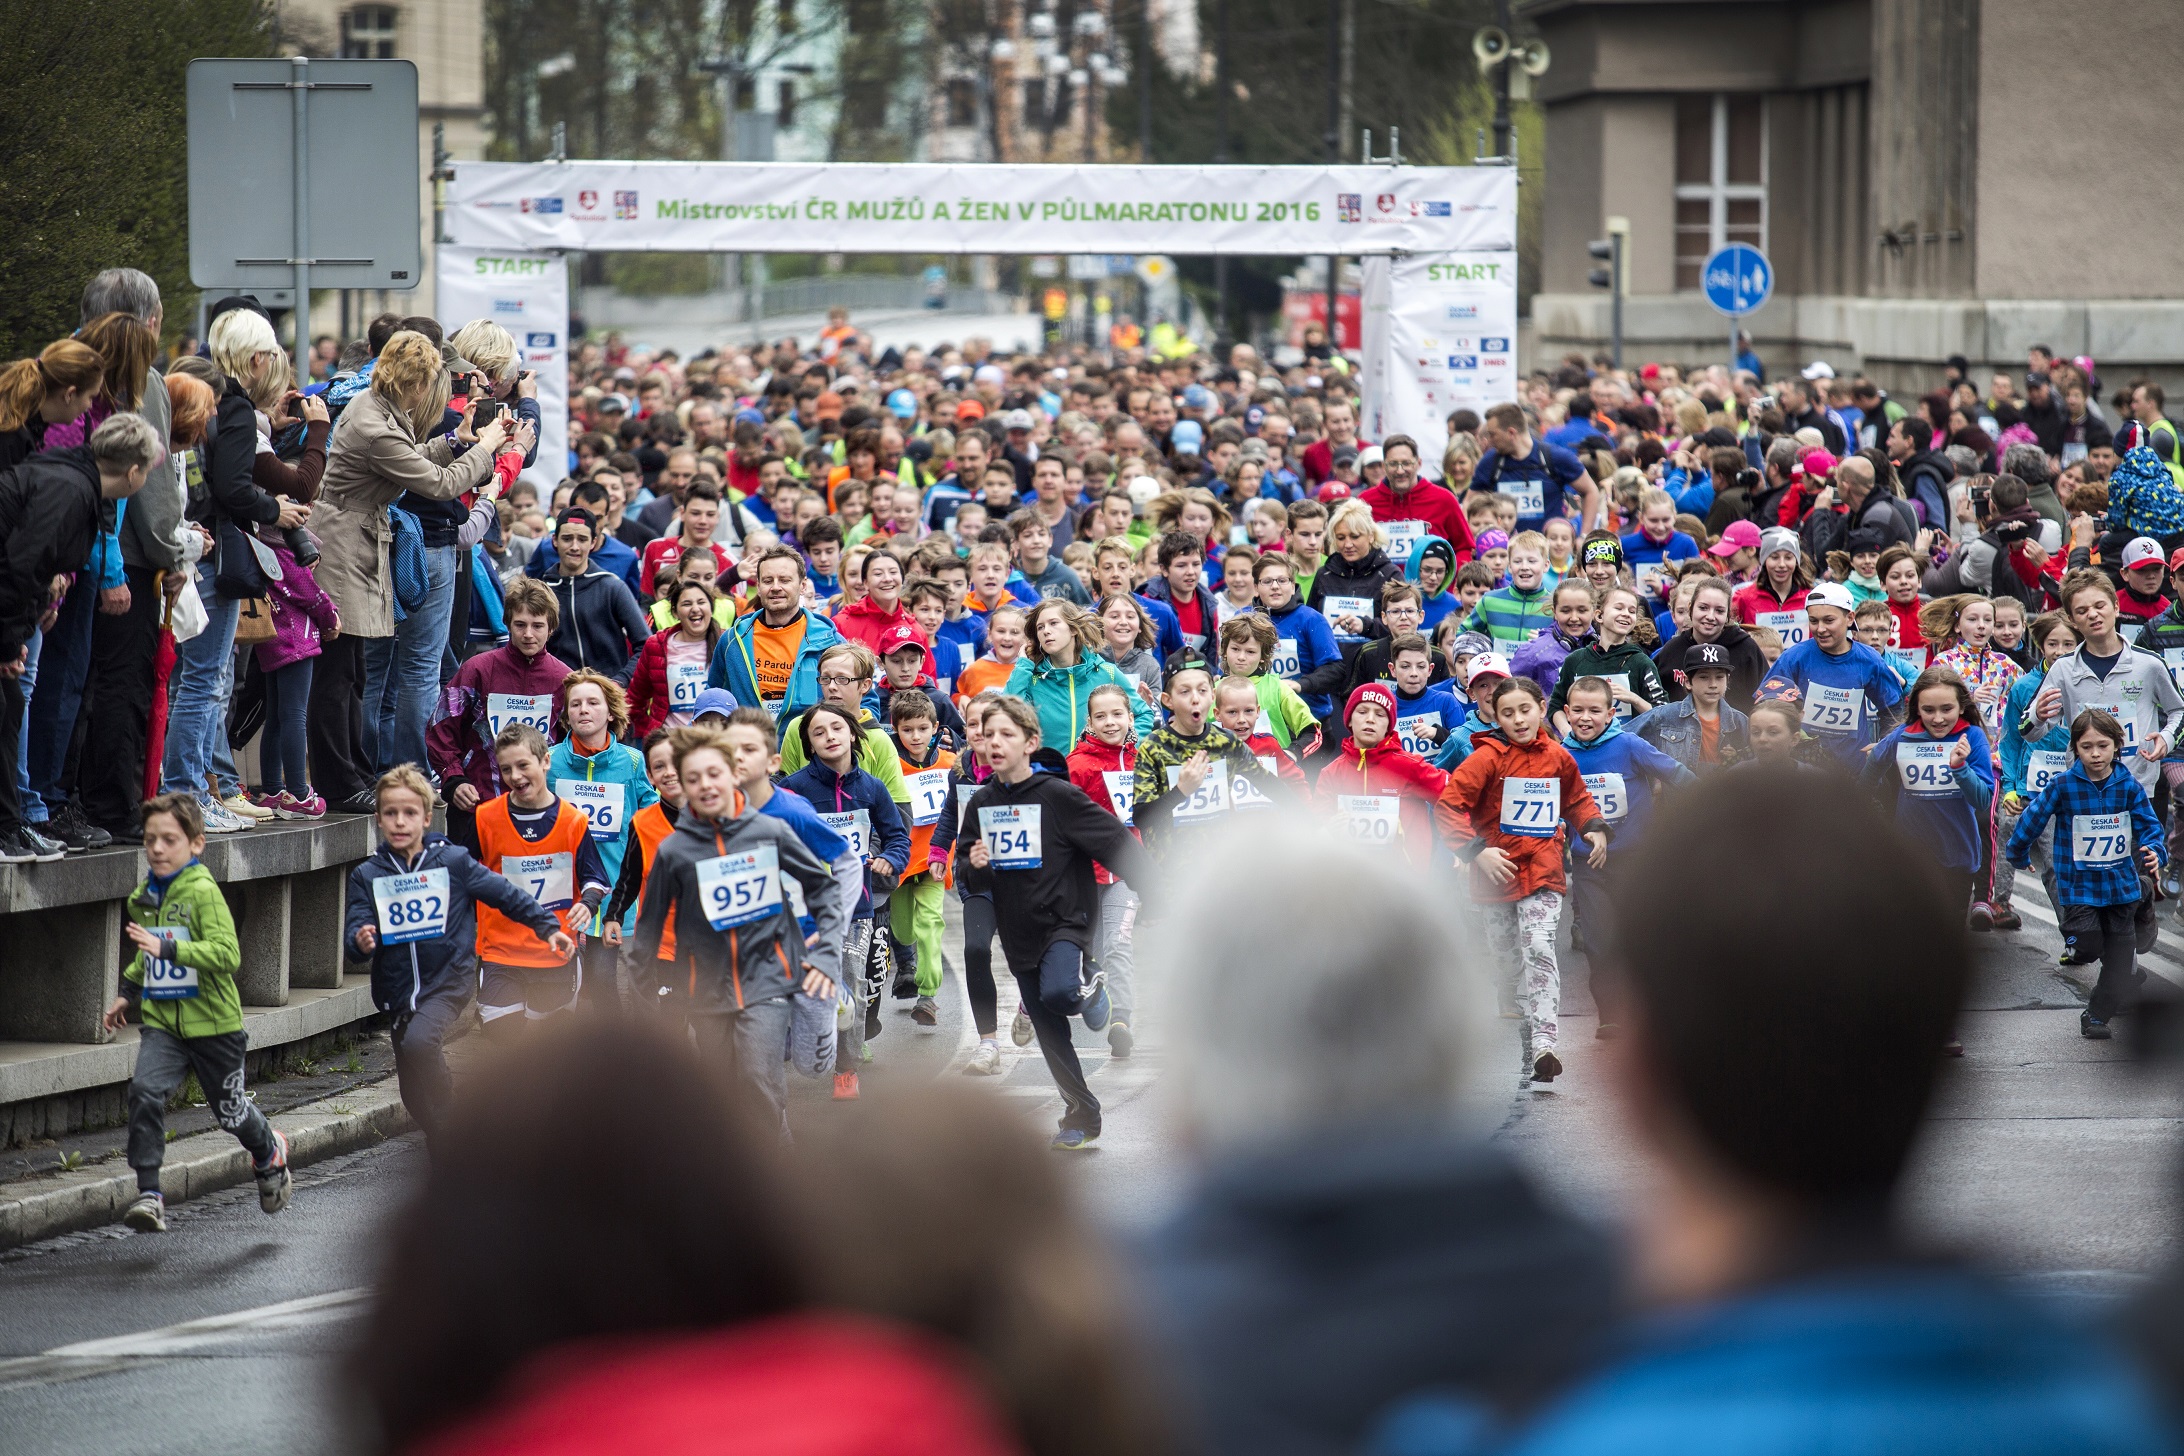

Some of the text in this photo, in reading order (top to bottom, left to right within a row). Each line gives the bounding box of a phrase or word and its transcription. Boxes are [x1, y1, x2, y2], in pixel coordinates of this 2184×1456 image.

[656, 195, 1321, 221] Mistrovství ČR MUŽŮ A ŽEN V PŮLMARATONU 2016
[475, 257, 549, 274] START
[1428, 264, 1500, 280] START
[1702, 646, 1719, 662] NY
[1362, 691, 1392, 711] BRONX
[1824, 689, 1844, 698] ČESKÁ
[506, 698, 529, 706] ČESKÁ
[1812, 703, 1853, 726] 752
[1916, 744, 1936, 753] ČESKÁ
[918, 772, 938, 782] ČESKÁ
[1905, 764, 1953, 785] 943
[574, 783, 598, 792] ČESKÁ
[569, 802, 613, 827] 26
[993, 810, 1013, 818] ČESKÁ
[1512, 800, 1553, 822] 771
[827, 815, 849, 824] ČESKÁ
[830, 821, 853, 829] POŘITELNA
[2091, 817, 2113, 825] ČESKÁ
[1348, 817, 1389, 840] 620
[841, 831, 861, 852] 3
[988, 830, 1030, 854] 754
[2082, 834, 2126, 857] 778
[521, 858, 545, 867] ČESKÁ
[522, 865, 552, 873] SPOŘITELNA
[394, 876, 419, 887] ČESKÁ
[531, 878, 545, 900] 7
[713, 875, 768, 912] 957
[388, 895, 444, 927] 882
